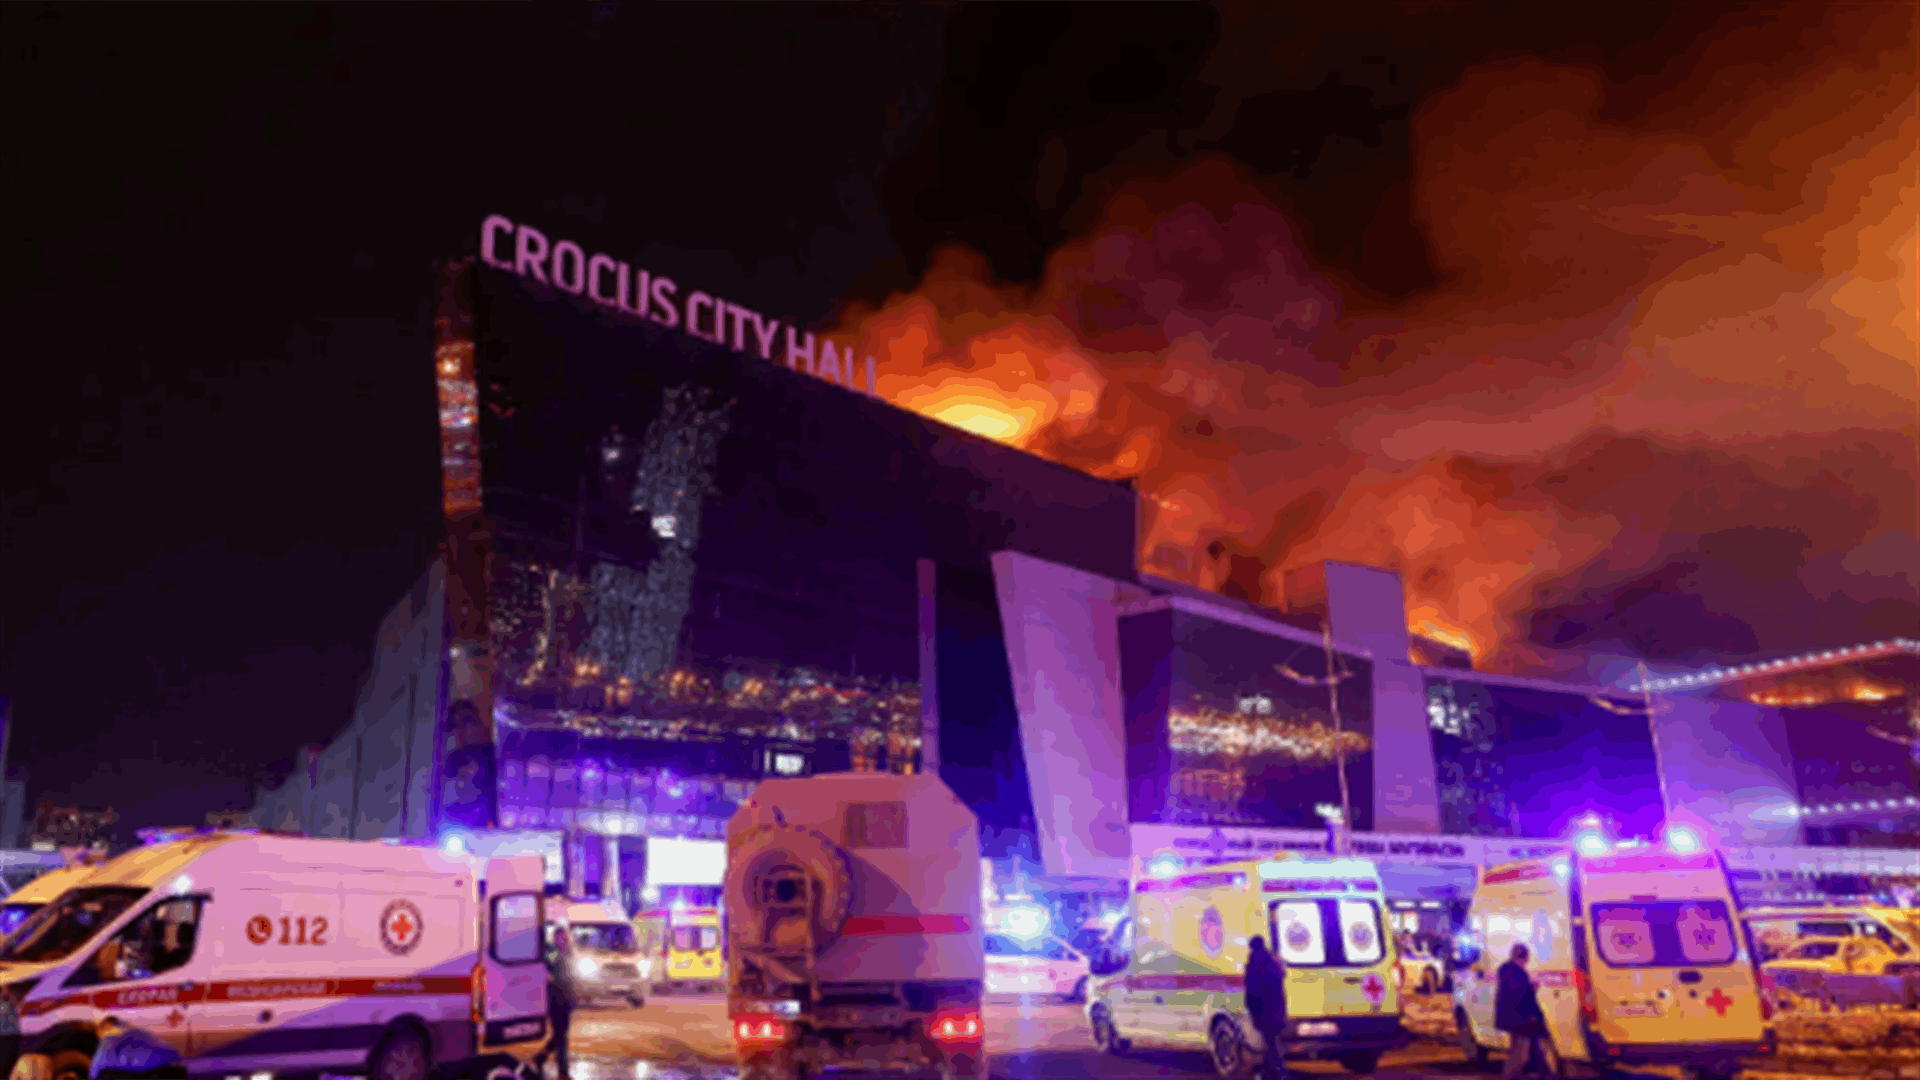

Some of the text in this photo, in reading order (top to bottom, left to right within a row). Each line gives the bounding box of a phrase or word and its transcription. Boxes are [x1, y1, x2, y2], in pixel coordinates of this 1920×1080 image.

[481, 214, 680, 328] CROCUS
[685, 290, 780, 360] CITY
[277, 915, 329, 947] 112
